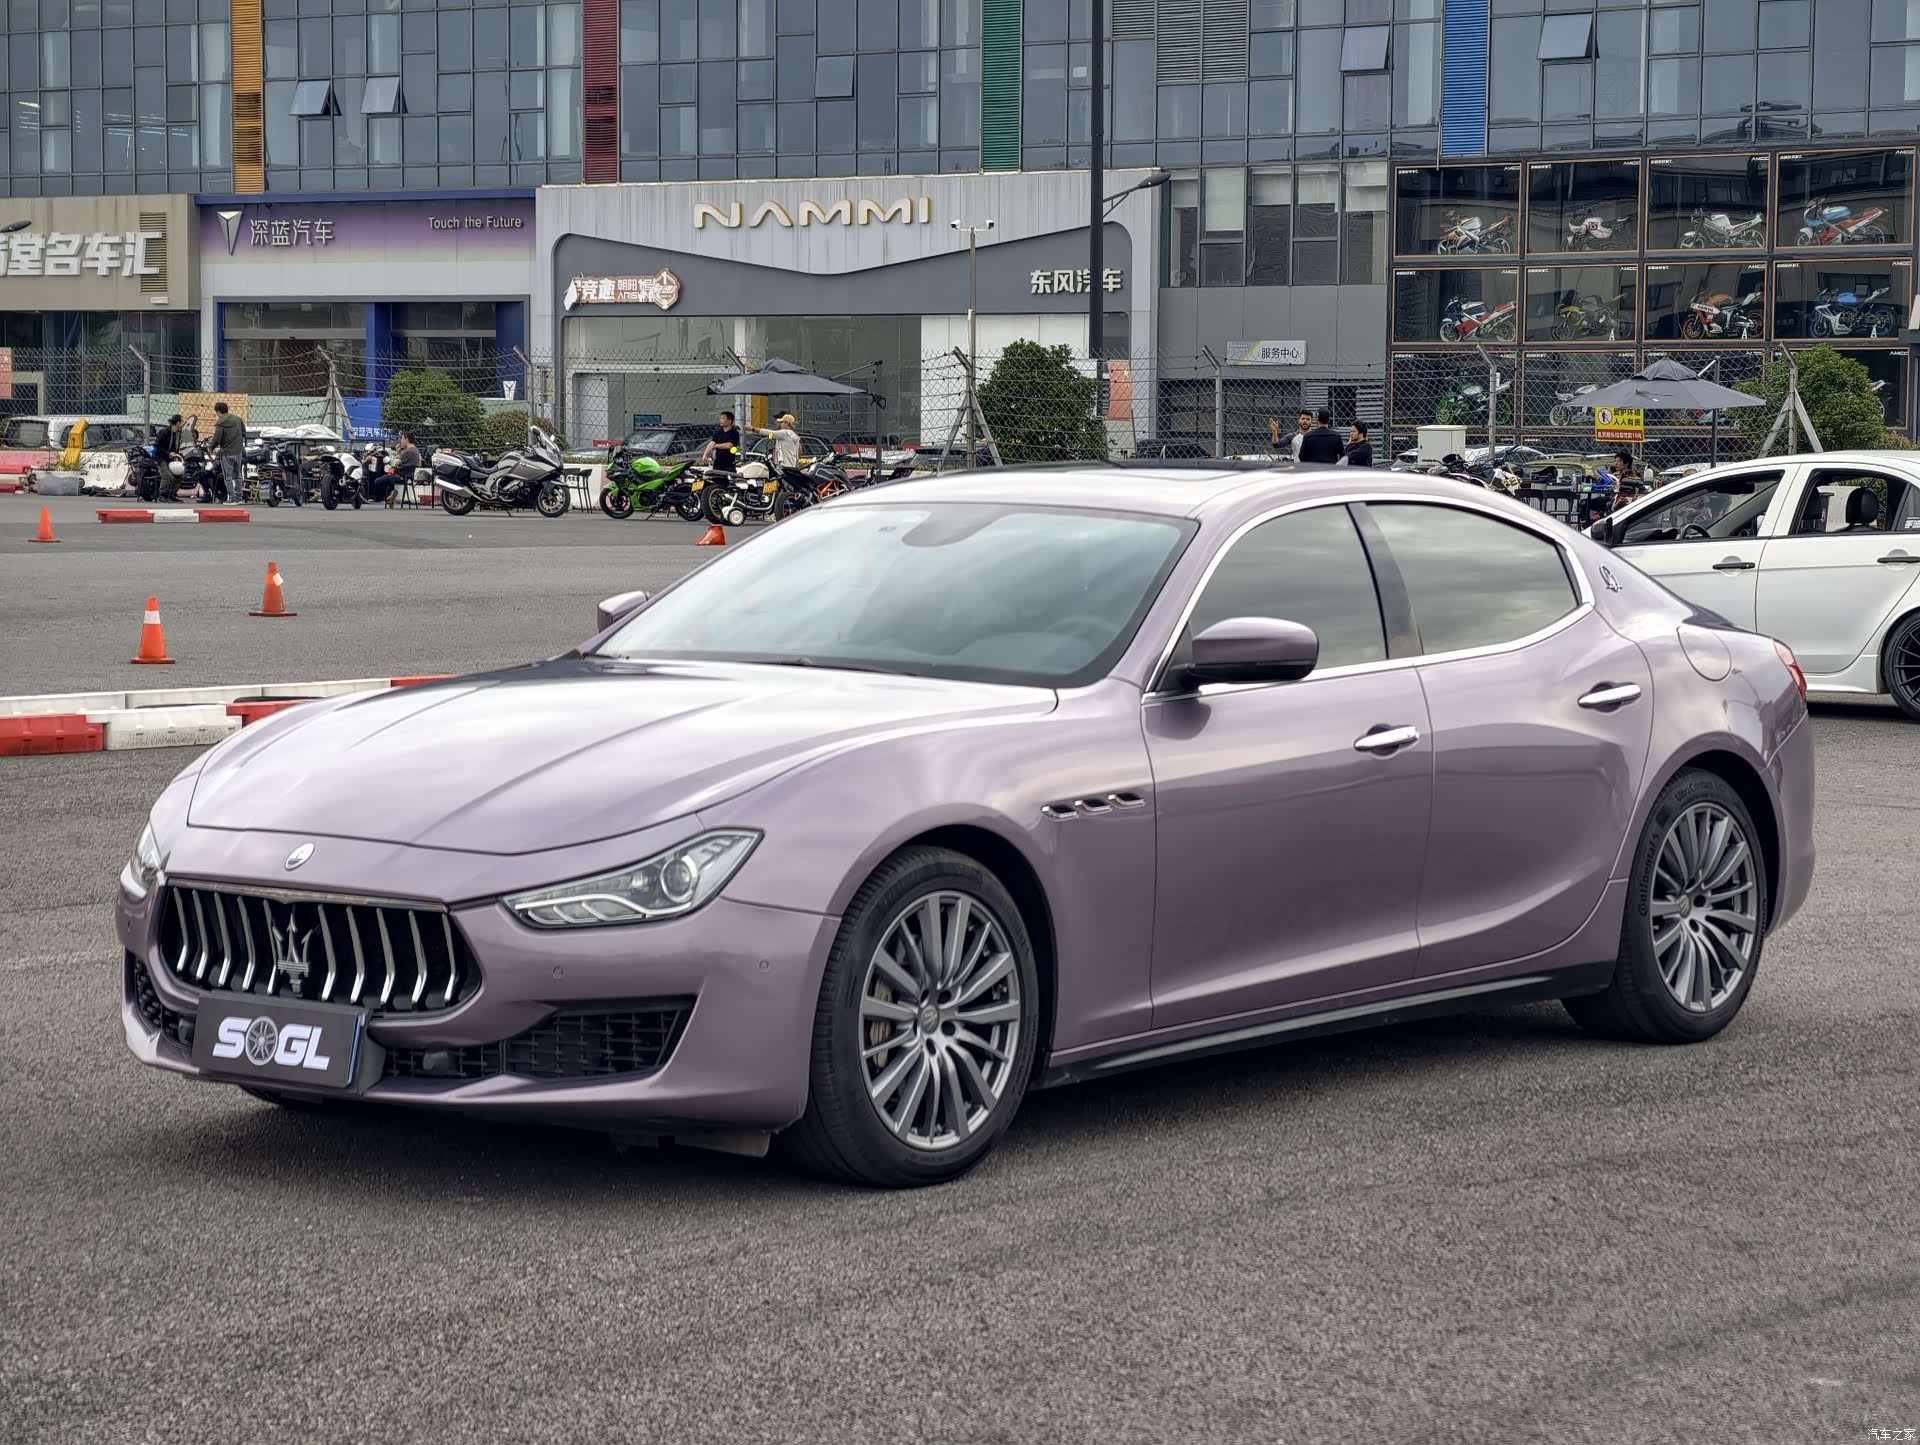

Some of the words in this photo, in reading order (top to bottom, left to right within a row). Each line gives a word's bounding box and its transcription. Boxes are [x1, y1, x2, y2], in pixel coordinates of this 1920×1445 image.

[427, 216, 460, 230] Touch
[464, 215, 482, 229] the
[486, 215, 523, 229] Future
[694, 196, 932, 229] NAMMI
[250, 217, 335, 247] 深蓝汽车
[1030, 268, 1123, 295] 东风汽车
[1261, 346, 1300, 359] 服务中心
[1613, 418, 1641, 426] 人人有责
[212, 1015, 331, 1071] SOGL
